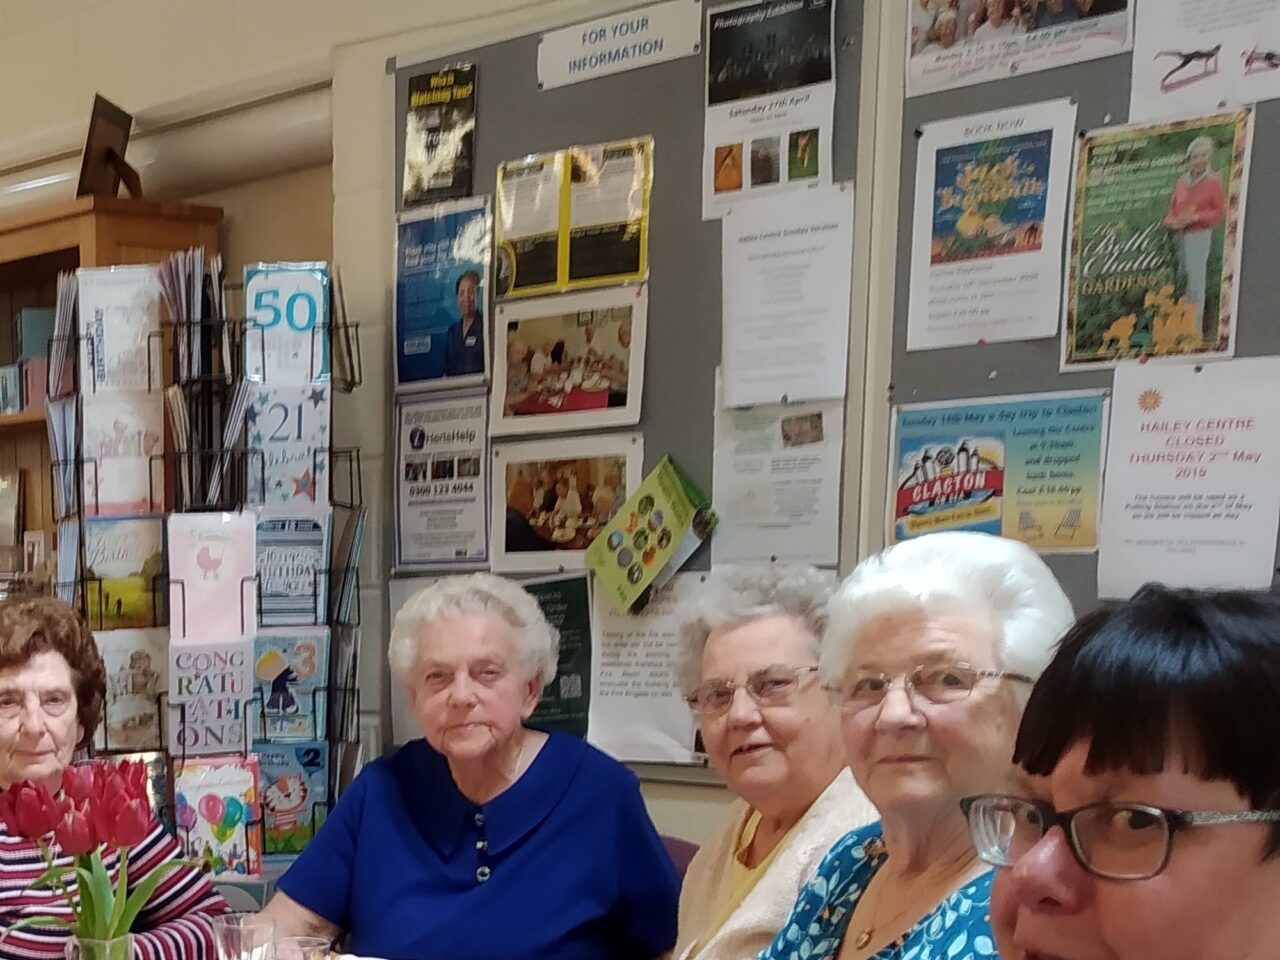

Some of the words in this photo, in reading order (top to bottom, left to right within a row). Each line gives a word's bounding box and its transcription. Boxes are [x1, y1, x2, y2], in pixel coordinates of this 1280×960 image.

[581, 28, 607, 47] FOR
[611, 17, 650, 39] YOUR
[568, 38, 665, 74] INFORMATION
[252, 289, 317, 333] 50
[268, 402, 303, 443] 21
[1140, 419, 1193, 433] HAILEY
[1196, 417, 1256, 431] CENTRE
[1165, 434, 1225, 448] CLOSED
[1129, 451, 1206, 464] THURSDAY
[1232, 450, 1263, 464] May
[912, 471, 986, 503] CLACTON
[175, 650, 245, 671] CONG
[294, 640, 317, 678] 3
[177, 671, 244, 696] RATU
[176, 722, 244, 748] ONS
[303, 748, 322, 767] 2
